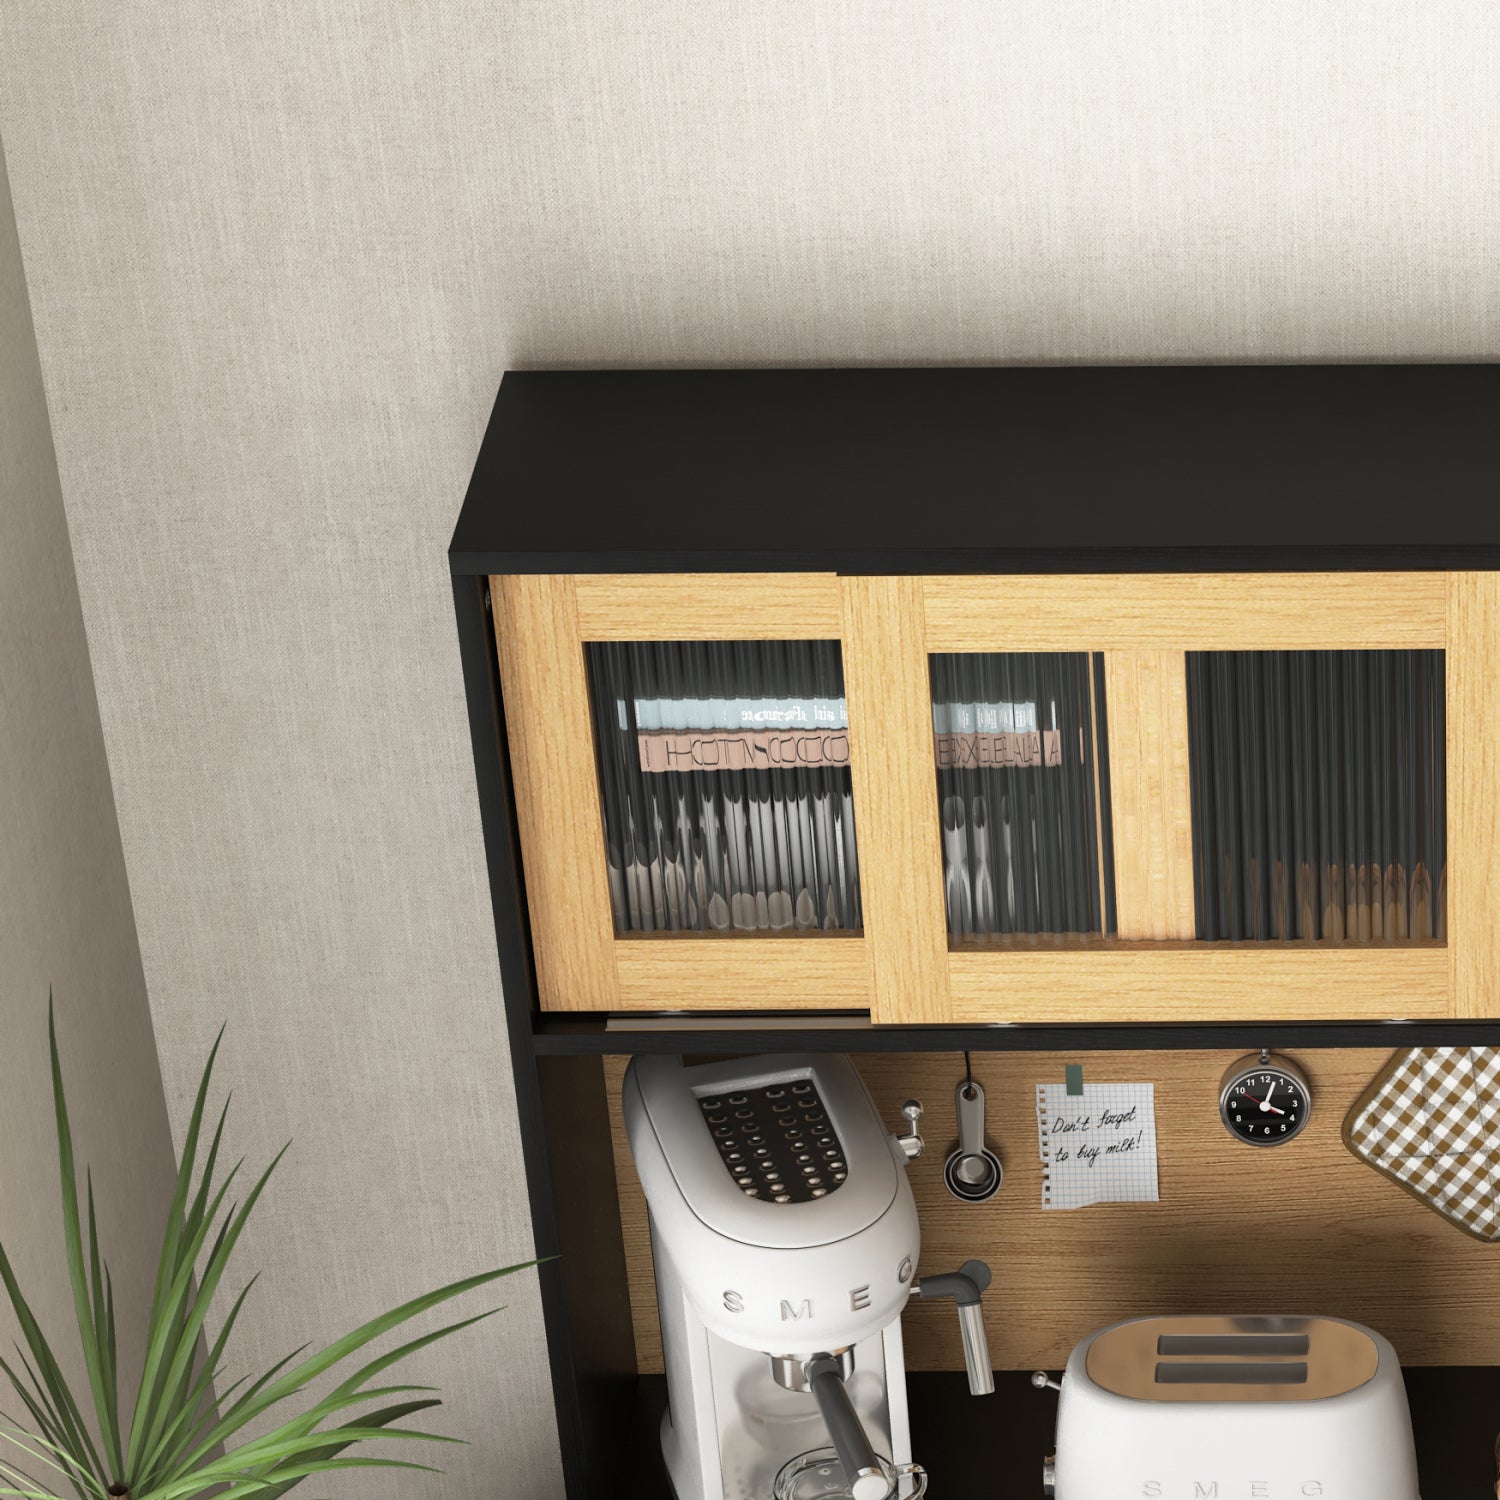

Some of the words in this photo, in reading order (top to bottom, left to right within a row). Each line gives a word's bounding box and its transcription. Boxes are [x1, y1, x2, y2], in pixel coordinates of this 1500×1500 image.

[1052, 1116, 1090, 1134] Don't
[1097, 1106, 1136, 1130] forget
[1055, 1147, 1069, 1162] to
[1077, 1143, 1099, 1168] buy
[1106, 1130, 1143, 1154] milk!
[722, 1256, 912, 1322] SMEG
[1141, 1480, 1325, 1499] SMEG
